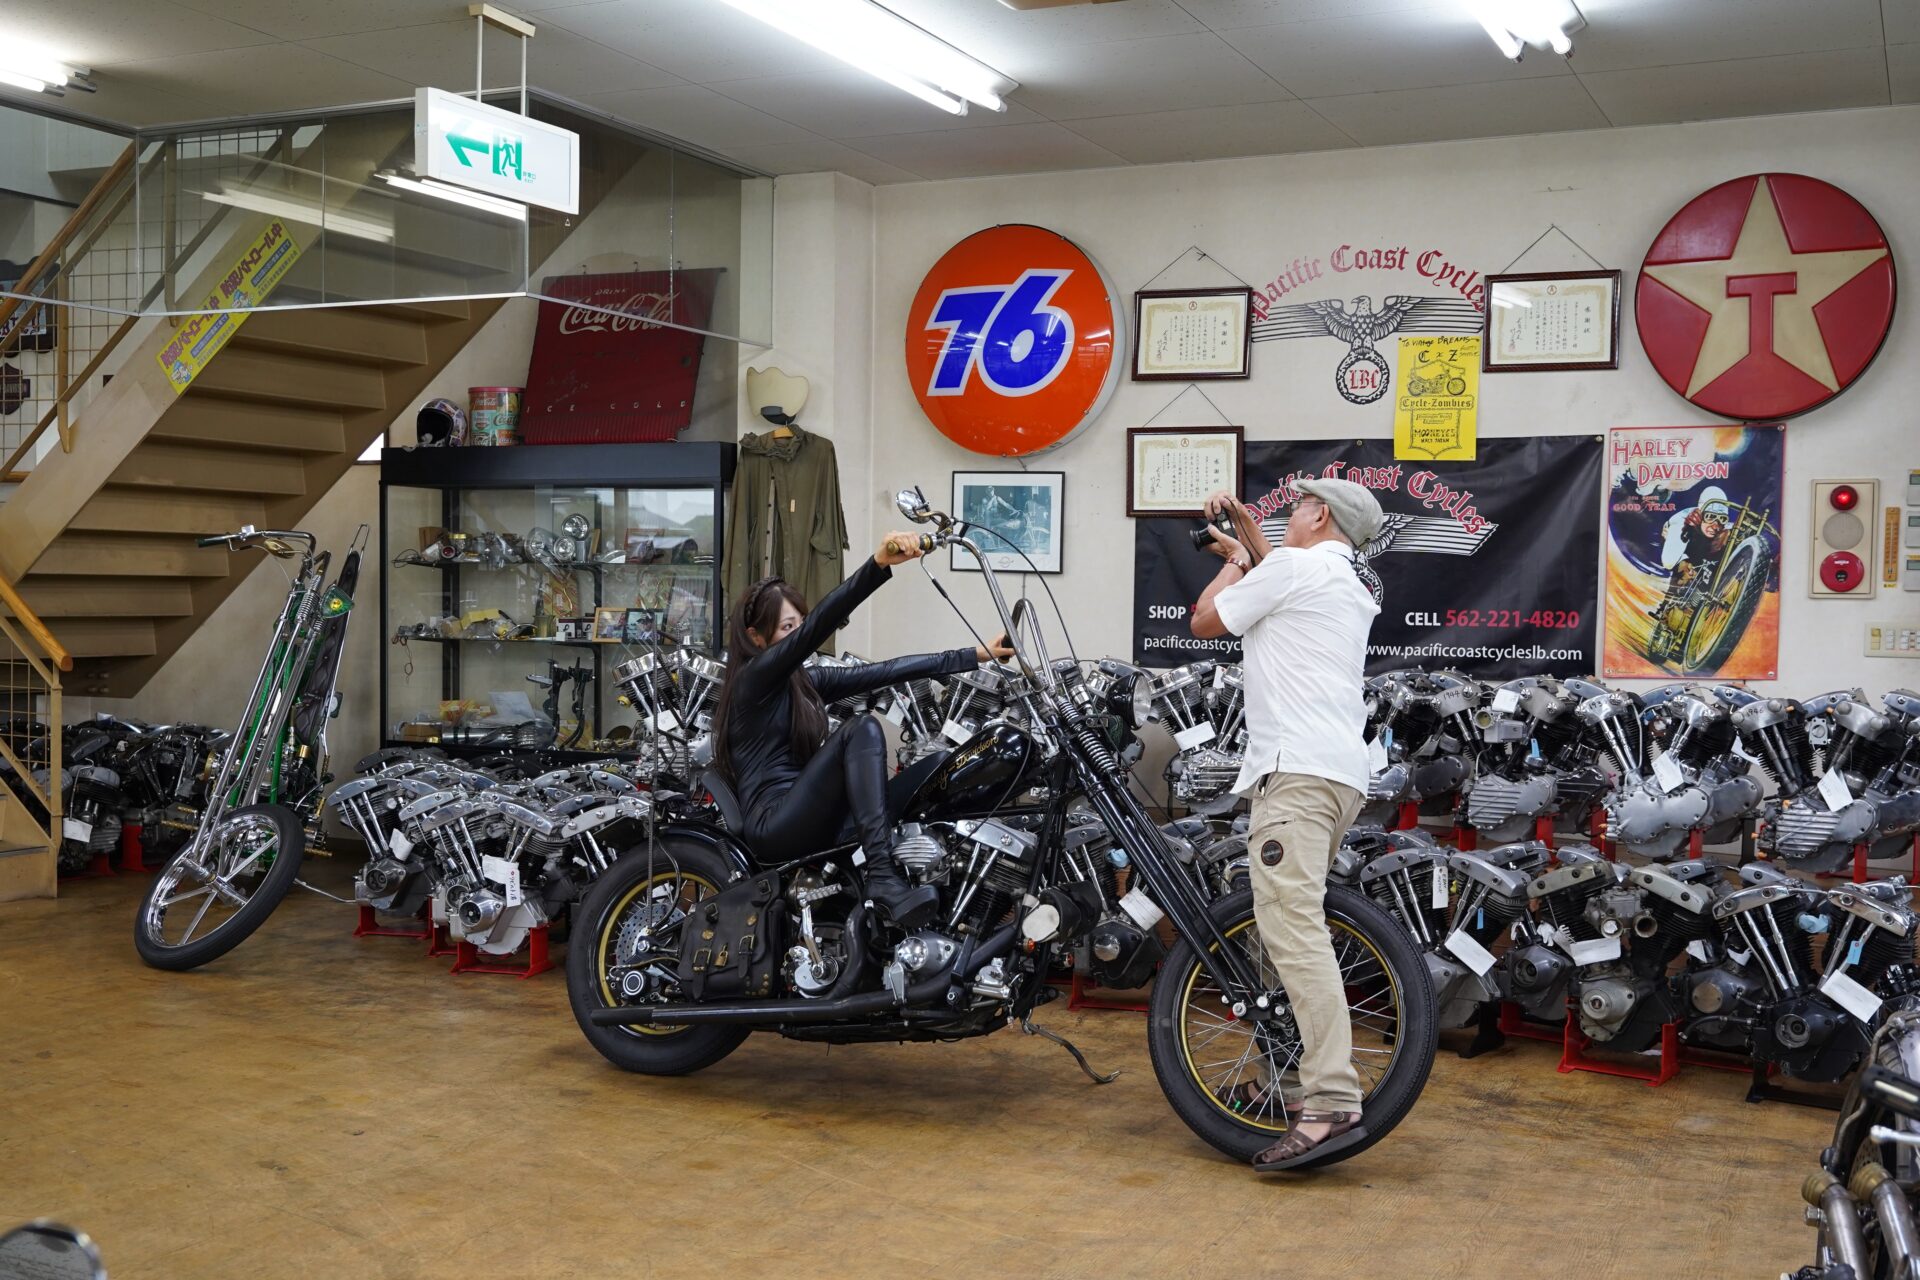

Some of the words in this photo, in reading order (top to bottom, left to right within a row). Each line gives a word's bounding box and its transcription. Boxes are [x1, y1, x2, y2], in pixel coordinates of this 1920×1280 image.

[595, 288, 628, 296] DRINK
[1252, 255, 1324, 323] Pacific
[1330, 244, 1410, 273] Coast
[559, 292, 681, 335] Coca-Cola
[1726, 271, 1798, 355] T
[925, 268, 1076, 397] 76
[1448, 349, 1458, 362] Z
[1402, 398, 1472, 409] Cycle-Zombies
[1612, 438, 1693, 466] HARLEY
[1637, 461, 1730, 487] DAVIDSON
[1244, 470, 1315, 527] Pacif
[1407, 471, 1492, 535] Cycles
[1613, 503, 1642, 513] GOOD
[1646, 503, 1677, 513] YEAR
[1148, 605, 1187, 620] SHOP
[1405, 612, 1441, 627] CELL
[1444, 609, 1580, 629] 562-221-4820
[1366, 642, 1584, 662] www.pacificcoastcycleslb.com
